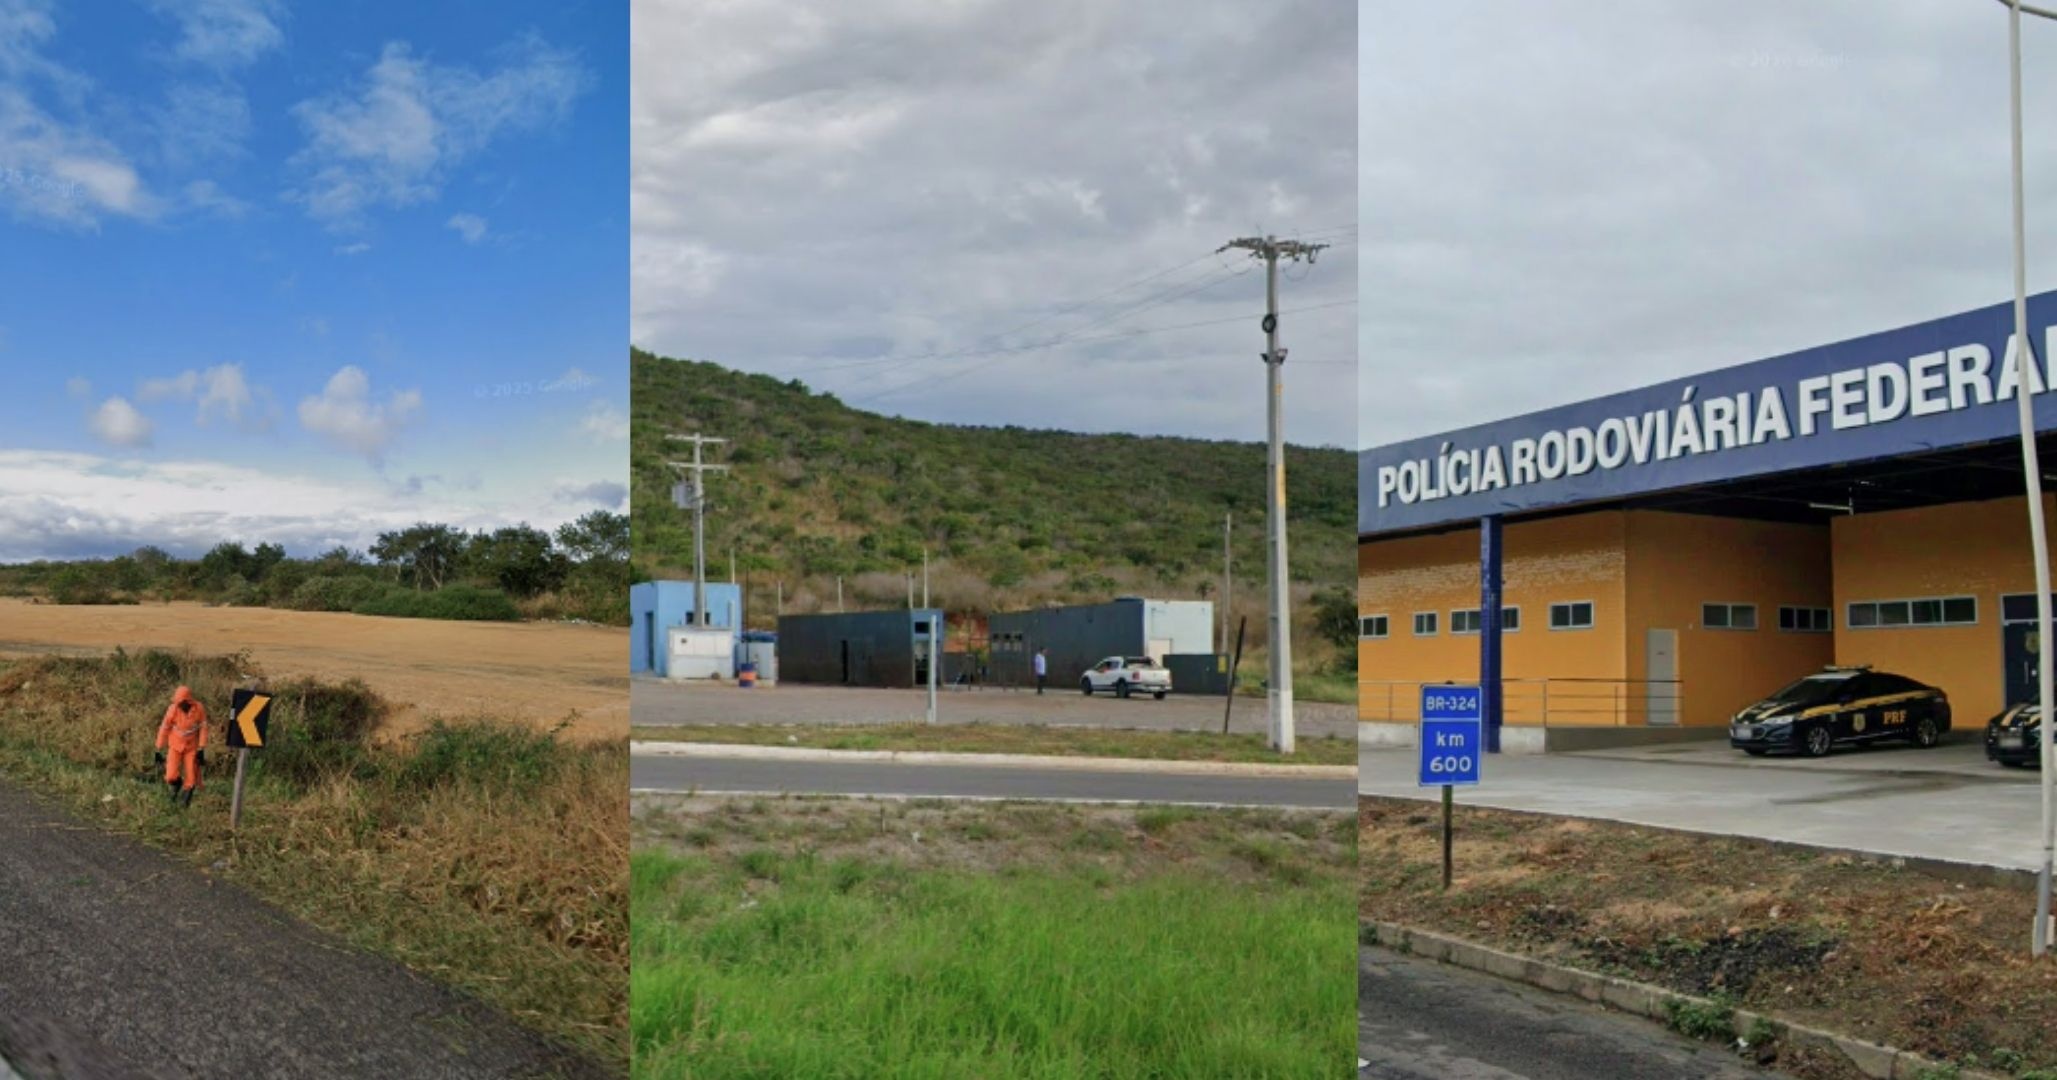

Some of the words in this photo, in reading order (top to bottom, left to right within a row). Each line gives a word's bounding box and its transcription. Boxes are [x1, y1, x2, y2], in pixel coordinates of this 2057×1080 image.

[1378, 441, 1508, 508] POLÍCIA
[1512, 386, 1792, 486] RODOVIÁRIA
[1426, 696, 1476, 711] BR-324
[1883, 709, 1907, 725] PRF
[1436, 730, 1464, 747] km
[1430, 756, 1472, 772] 600
